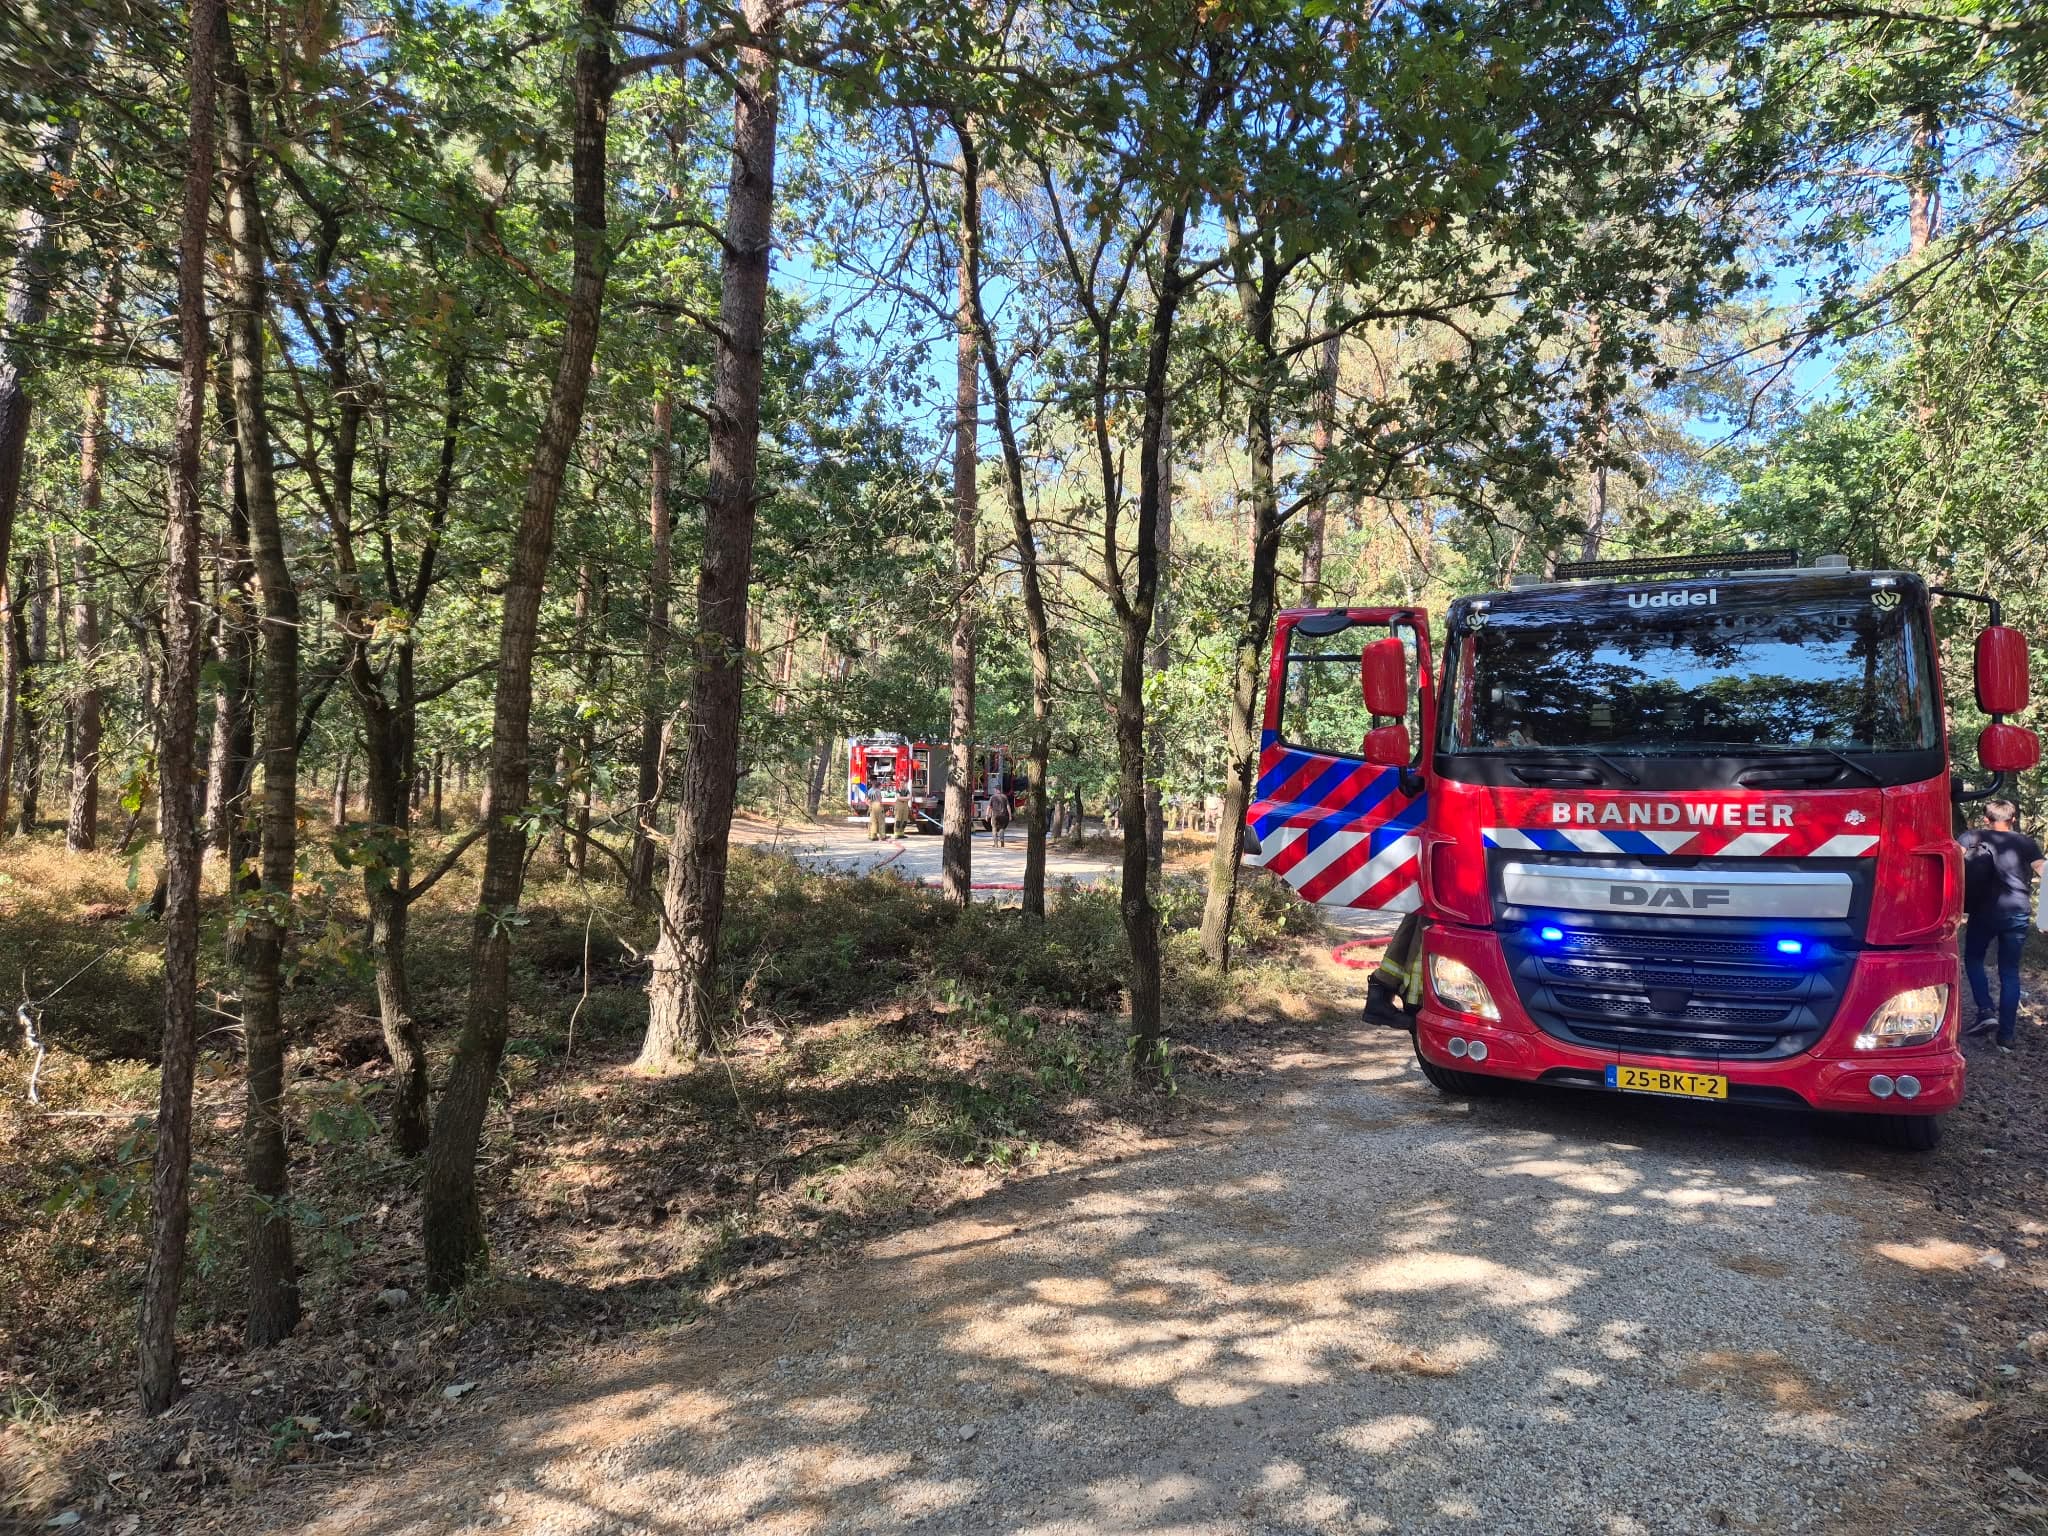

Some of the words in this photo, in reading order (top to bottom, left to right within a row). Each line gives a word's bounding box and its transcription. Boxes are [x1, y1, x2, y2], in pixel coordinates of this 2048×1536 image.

[1628, 588, 1717, 608] Uddel
[1551, 802, 1794, 827] BRANDWEER
[1609, 885, 1730, 909] DAF
[1625, 1070, 1718, 1094] 25-BKT-2
